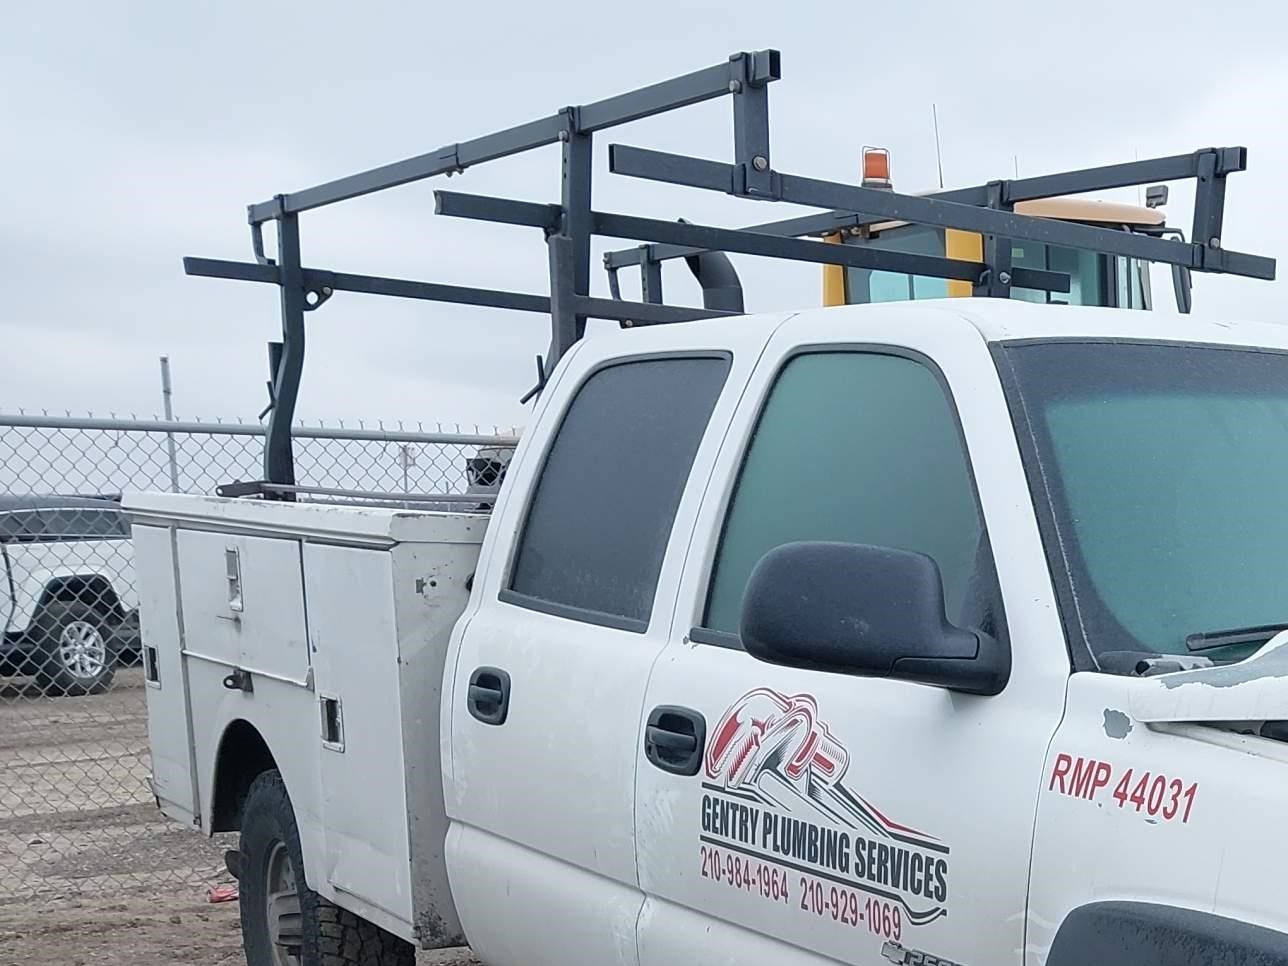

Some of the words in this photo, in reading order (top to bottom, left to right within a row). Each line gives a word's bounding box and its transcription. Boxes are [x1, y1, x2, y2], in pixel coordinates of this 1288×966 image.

[1049, 753, 1112, 800] RMP
[1113, 768, 1198, 823] 44031
[700, 846, 788, 904] 210-984-1964
[800, 877, 901, 941] 210-929-1069
[701, 794, 760, 845] GENTRY
[762, 811, 850, 874] PLUMBING
[854, 836, 947, 903] SERVICES
